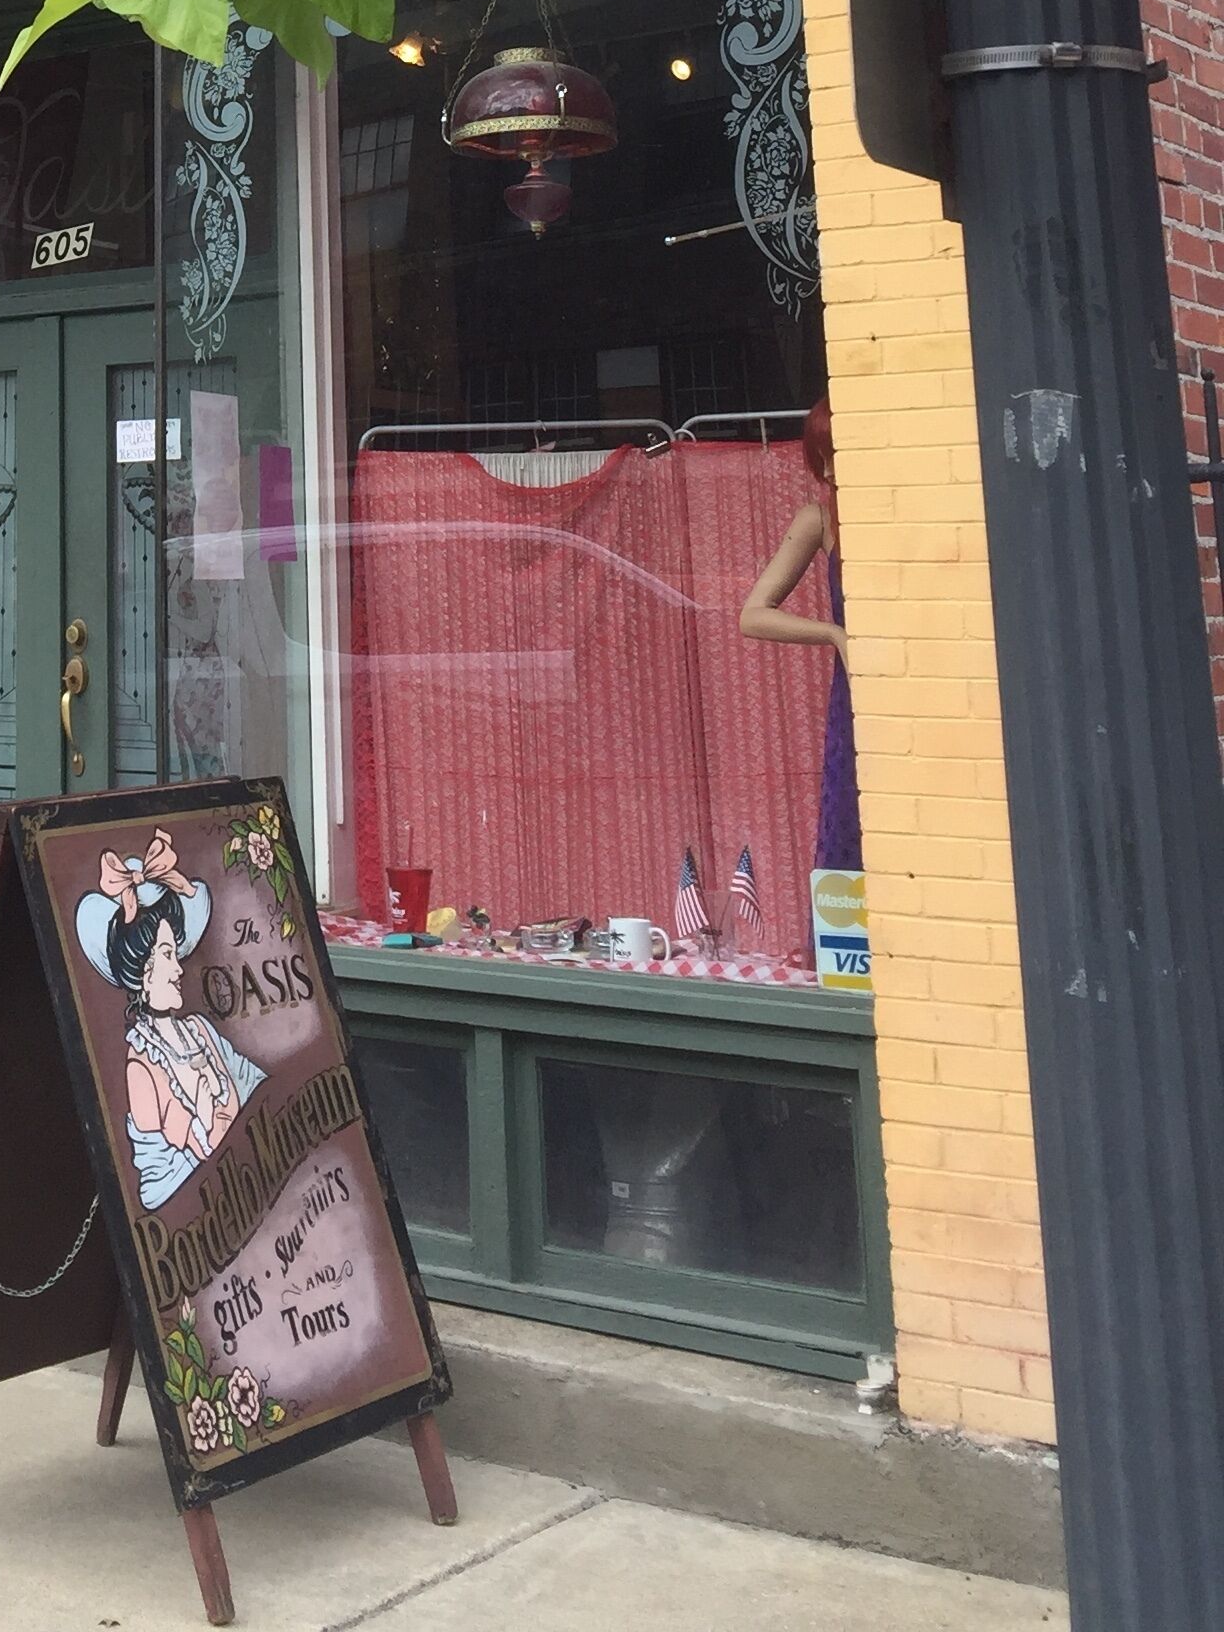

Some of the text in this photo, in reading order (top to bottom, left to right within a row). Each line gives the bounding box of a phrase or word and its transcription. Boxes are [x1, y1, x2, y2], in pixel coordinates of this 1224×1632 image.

[34, 229, 90, 266] 605
[230, 917, 263, 947] The
[833, 951, 872, 975] VIS
[201, 953, 314, 1021] OASIS
[135, 1064, 364, 1311] Bordello Museum
[306, 1264, 336, 1291] AND
[213, 1273, 264, 1356] gifts
[281, 1300, 350, 1348] Tours
